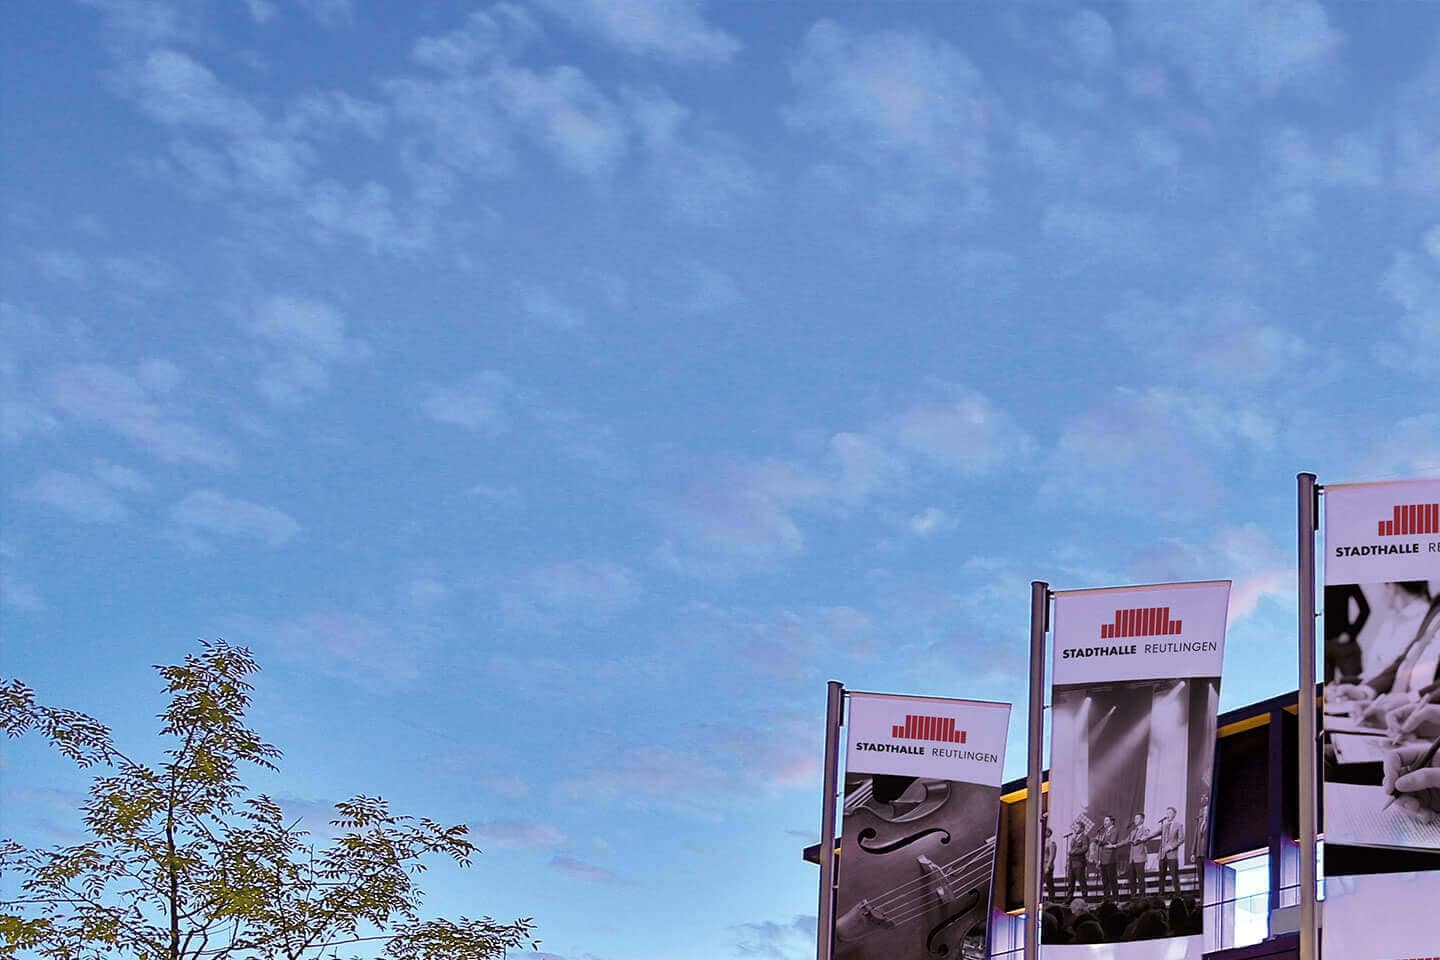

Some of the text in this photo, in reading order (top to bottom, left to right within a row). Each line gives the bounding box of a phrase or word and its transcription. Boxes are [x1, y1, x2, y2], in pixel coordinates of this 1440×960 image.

[1336, 543, 1419, 557] STADTHALLE
[1063, 641, 1217, 658] STADTHALLE REUTLINGEN
[856, 742, 998, 763] STADTHALLE REUTLINGEN
